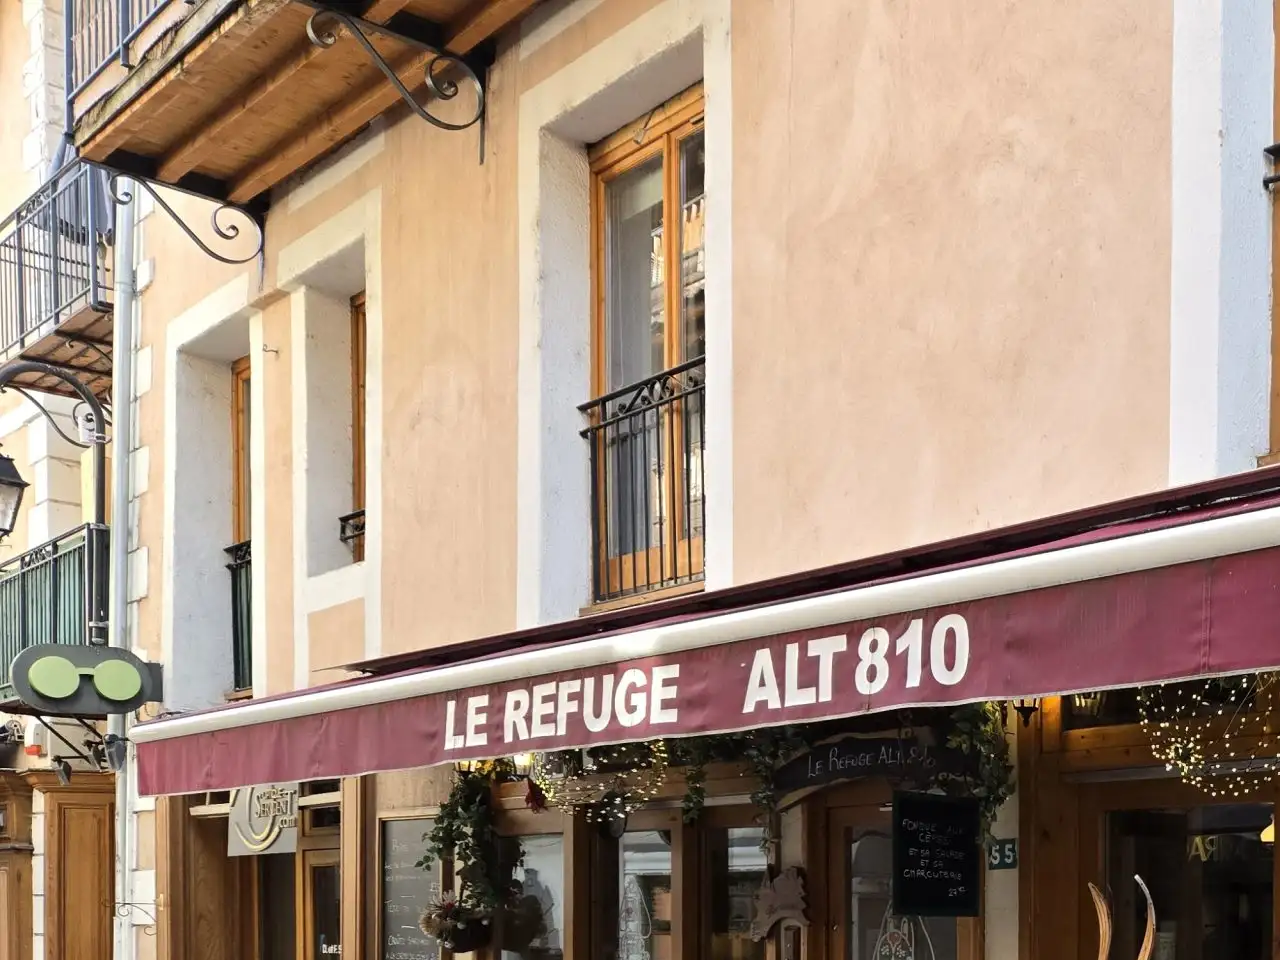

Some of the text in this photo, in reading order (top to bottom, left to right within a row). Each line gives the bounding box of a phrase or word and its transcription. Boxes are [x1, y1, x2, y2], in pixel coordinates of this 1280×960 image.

[443, 613, 971, 750] LE REFUGE ALT 810
